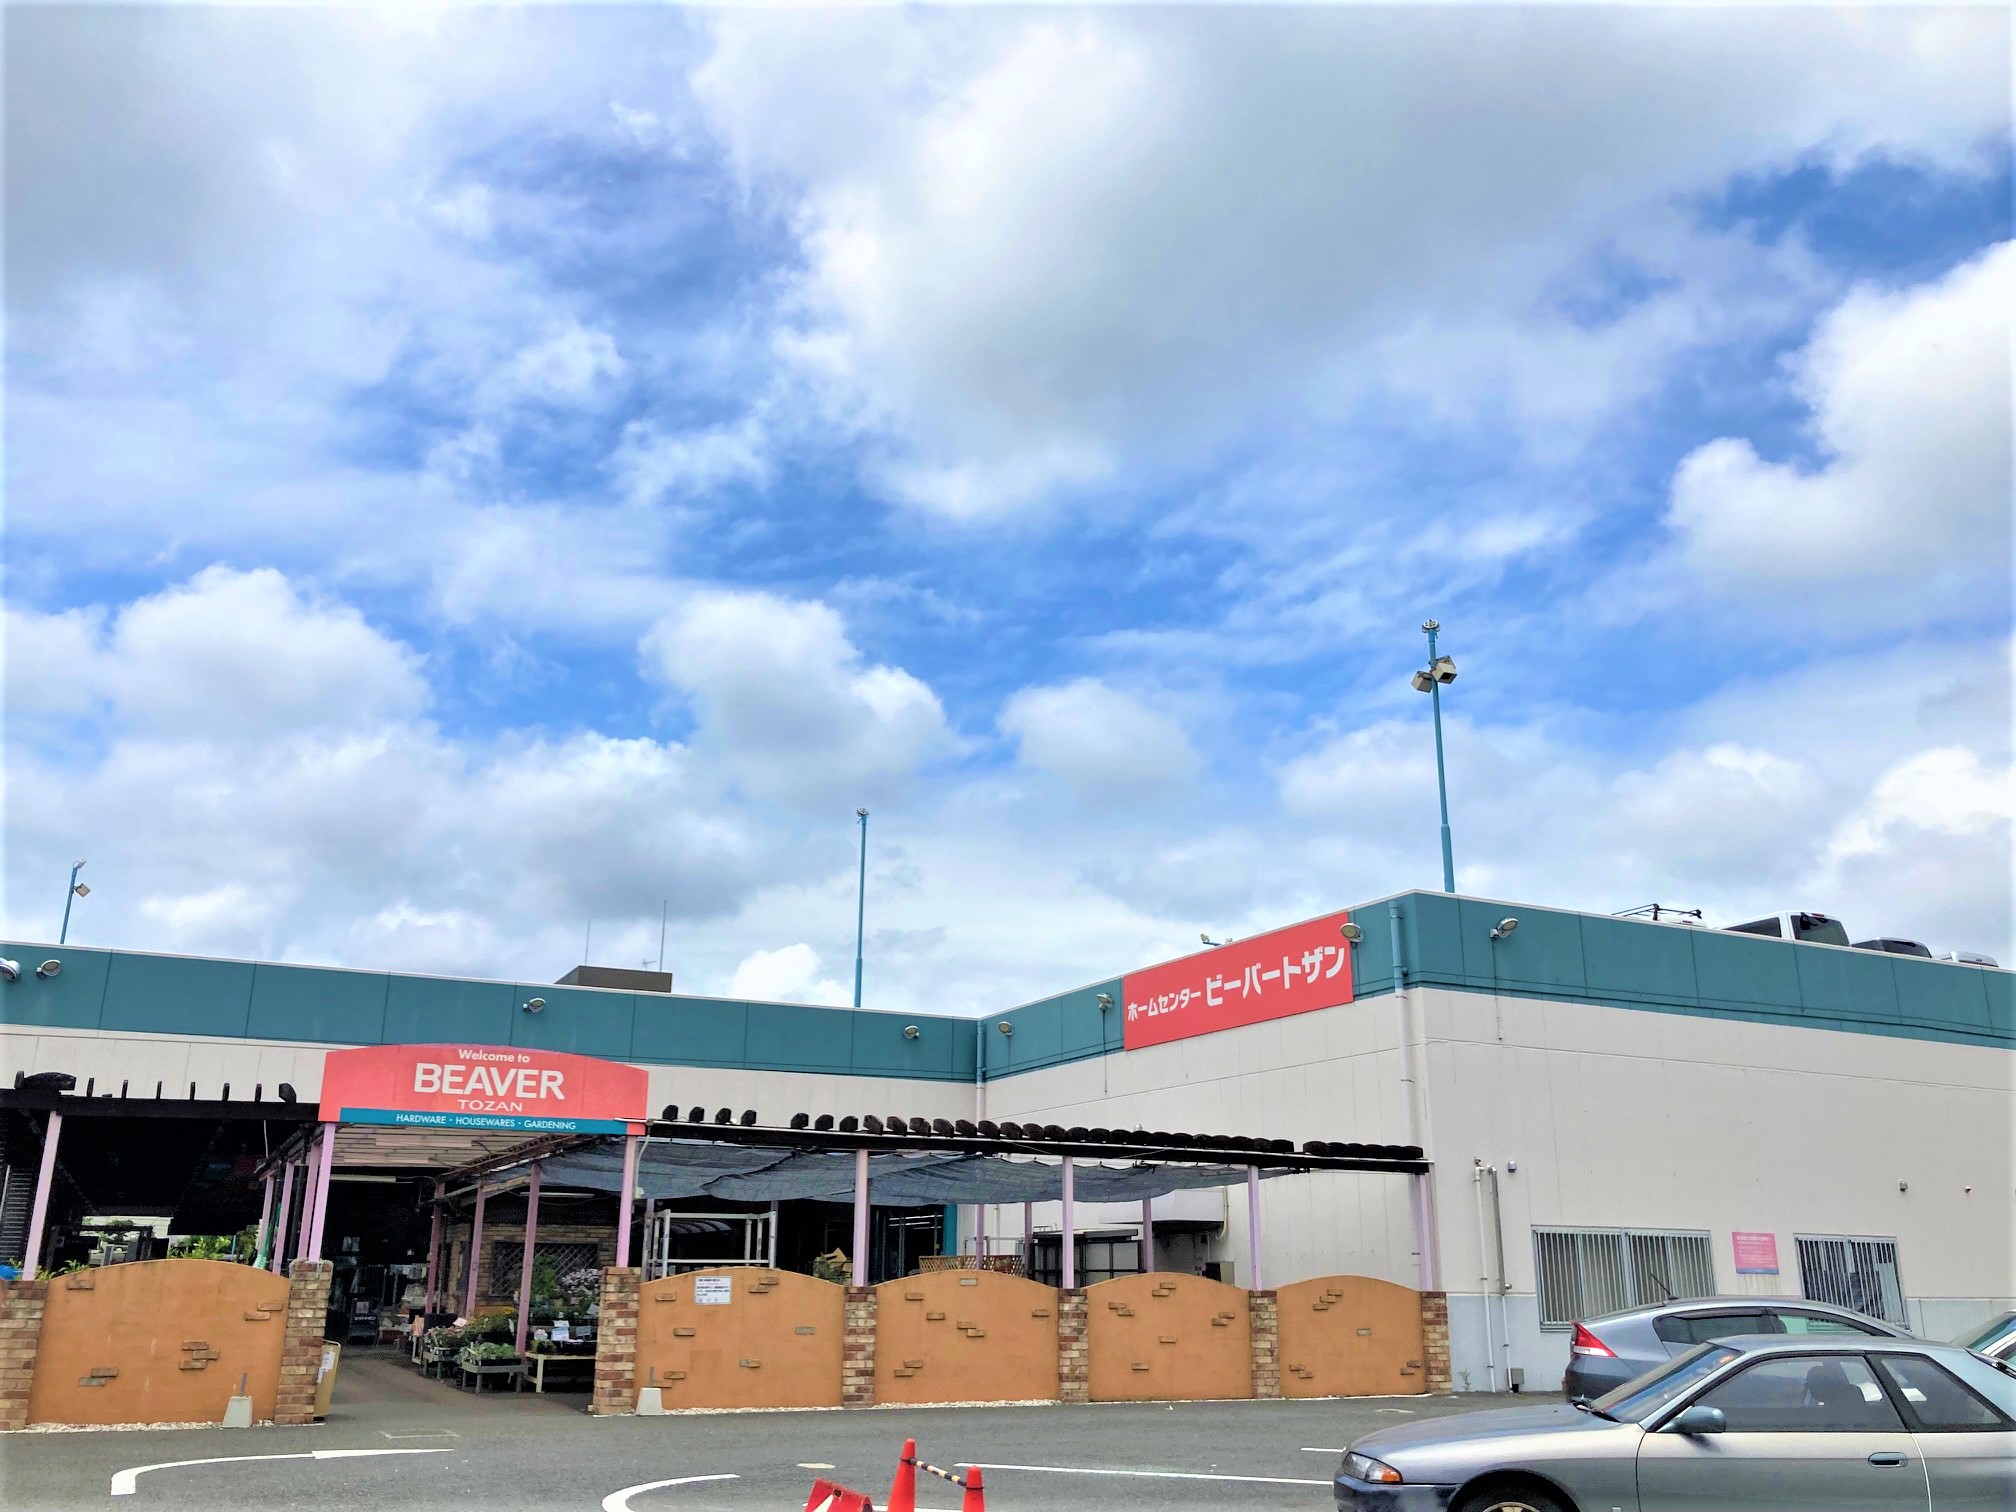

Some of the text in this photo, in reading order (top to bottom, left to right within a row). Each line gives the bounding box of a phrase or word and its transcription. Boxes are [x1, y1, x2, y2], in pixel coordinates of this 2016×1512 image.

[1127, 945, 1345, 1022] ホームセンター ビーバートザン
[458, 1048, 531, 1064] Welcome to
[414, 1062, 565, 1099] BEAVER
[458, 1099, 523, 1112] TOZAN
[396, 1114, 576, 1130] HARDWARE HOUSEWARES GARDENING
